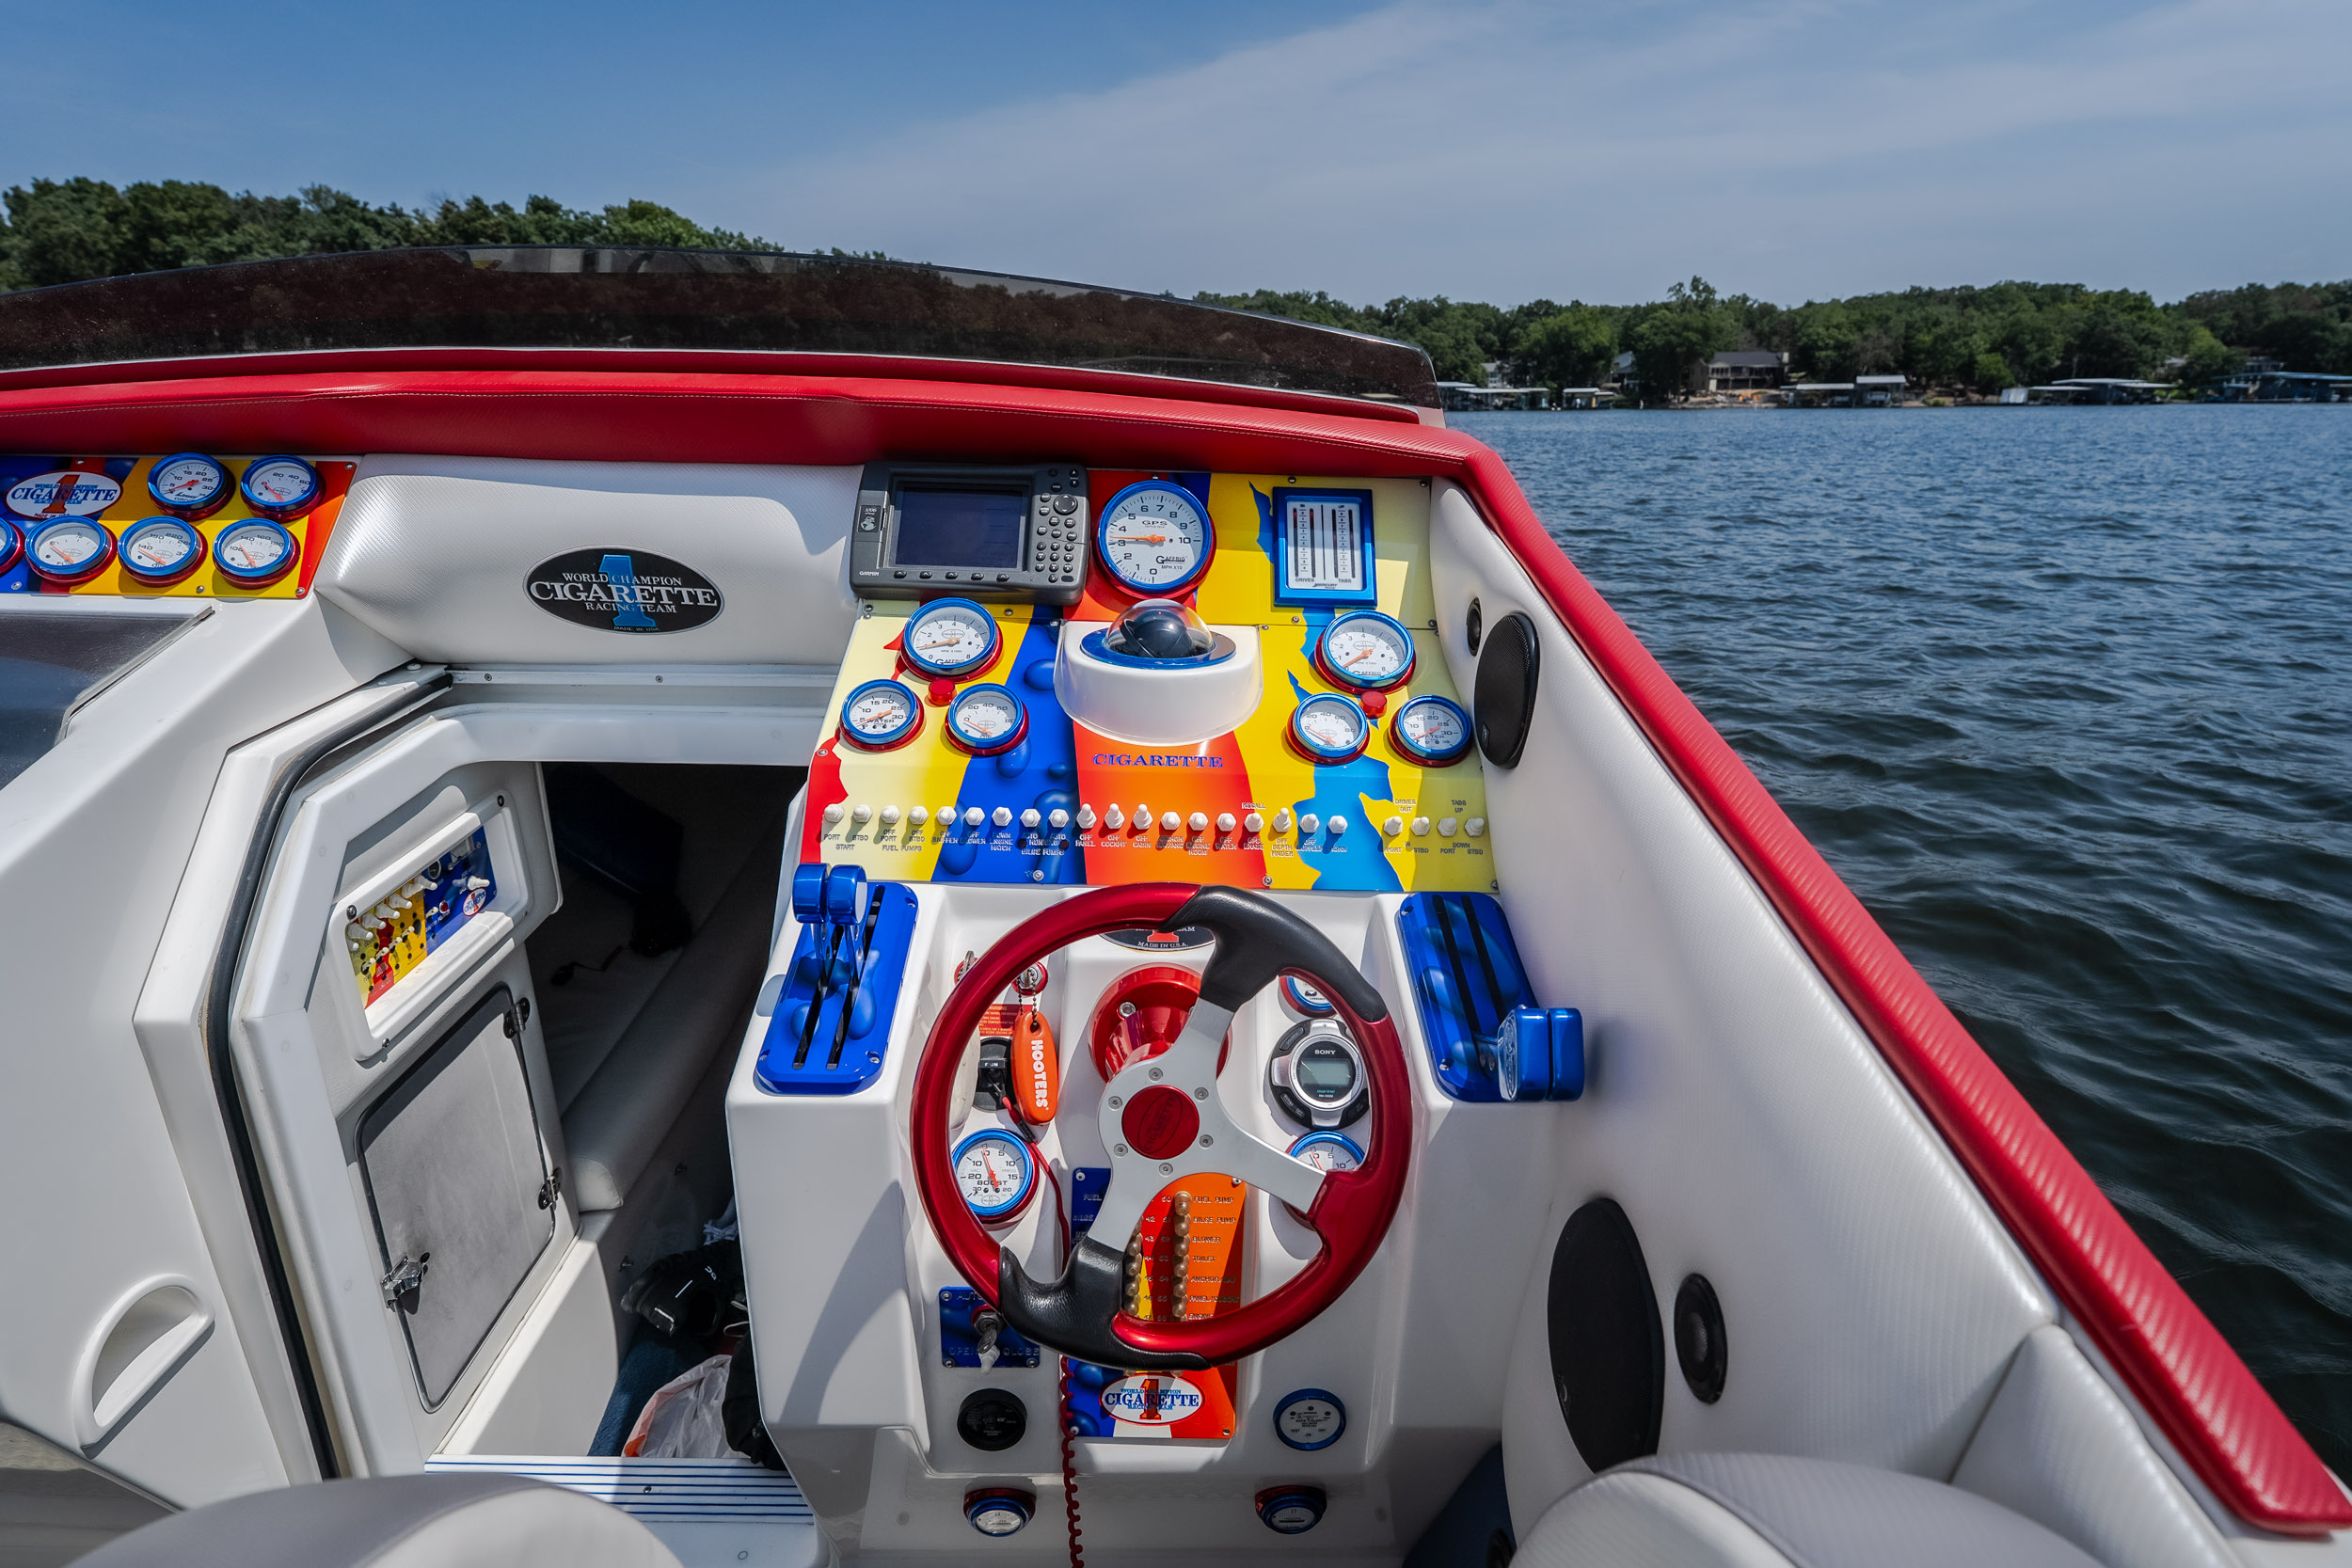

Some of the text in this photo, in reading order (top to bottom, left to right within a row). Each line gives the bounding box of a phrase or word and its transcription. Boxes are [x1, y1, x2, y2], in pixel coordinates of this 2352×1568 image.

[11, 488, 118, 500] CIGARETTE
[563, 573, 681, 585] WORLD CHAMPION
[530, 581, 717, 607] CIGARETTE
[586, 603, 676, 613] RACING TEAM
[1092, 754, 1223, 768] CIGARETTE
[1031, 1039, 1048, 1108] HOOTERS
[1104, 1393, 1199, 1406] CIGARETTE
